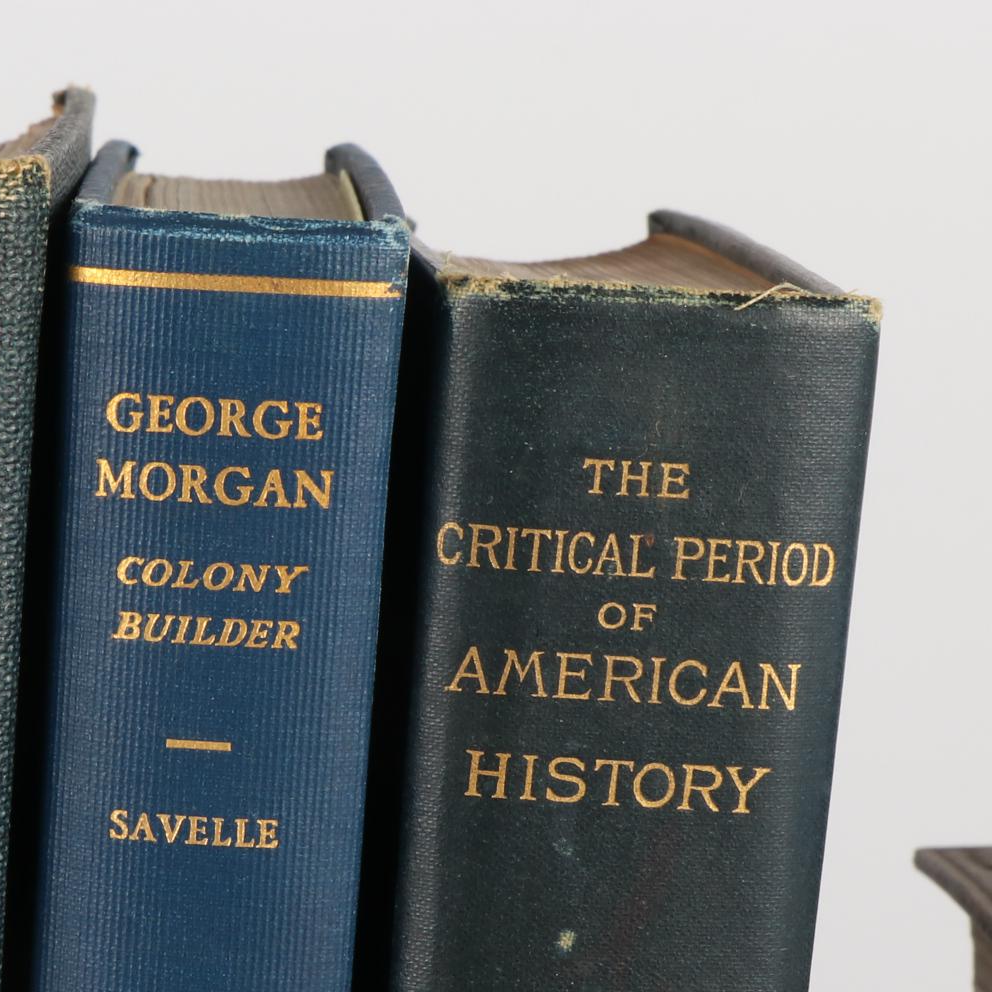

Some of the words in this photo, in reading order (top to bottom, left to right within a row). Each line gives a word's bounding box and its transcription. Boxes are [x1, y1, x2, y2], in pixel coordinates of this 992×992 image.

[106, 391, 325, 441] GEORGE
[95, 458, 335, 510] MORGAN
[582, 457, 690, 500] THE
[115, 556, 309, 595] COLONY
[436, 521, 657, 580] CRITICAL
[670, 536, 837, 588] PERIOD
[113, 611, 302, 651] BUILDER
[597, 601, 658, 632] OF
[444, 645, 803, 712] AMERICAN
[464, 748, 773, 815] HISTORY
[108, 809, 280, 850] SAVELLE
